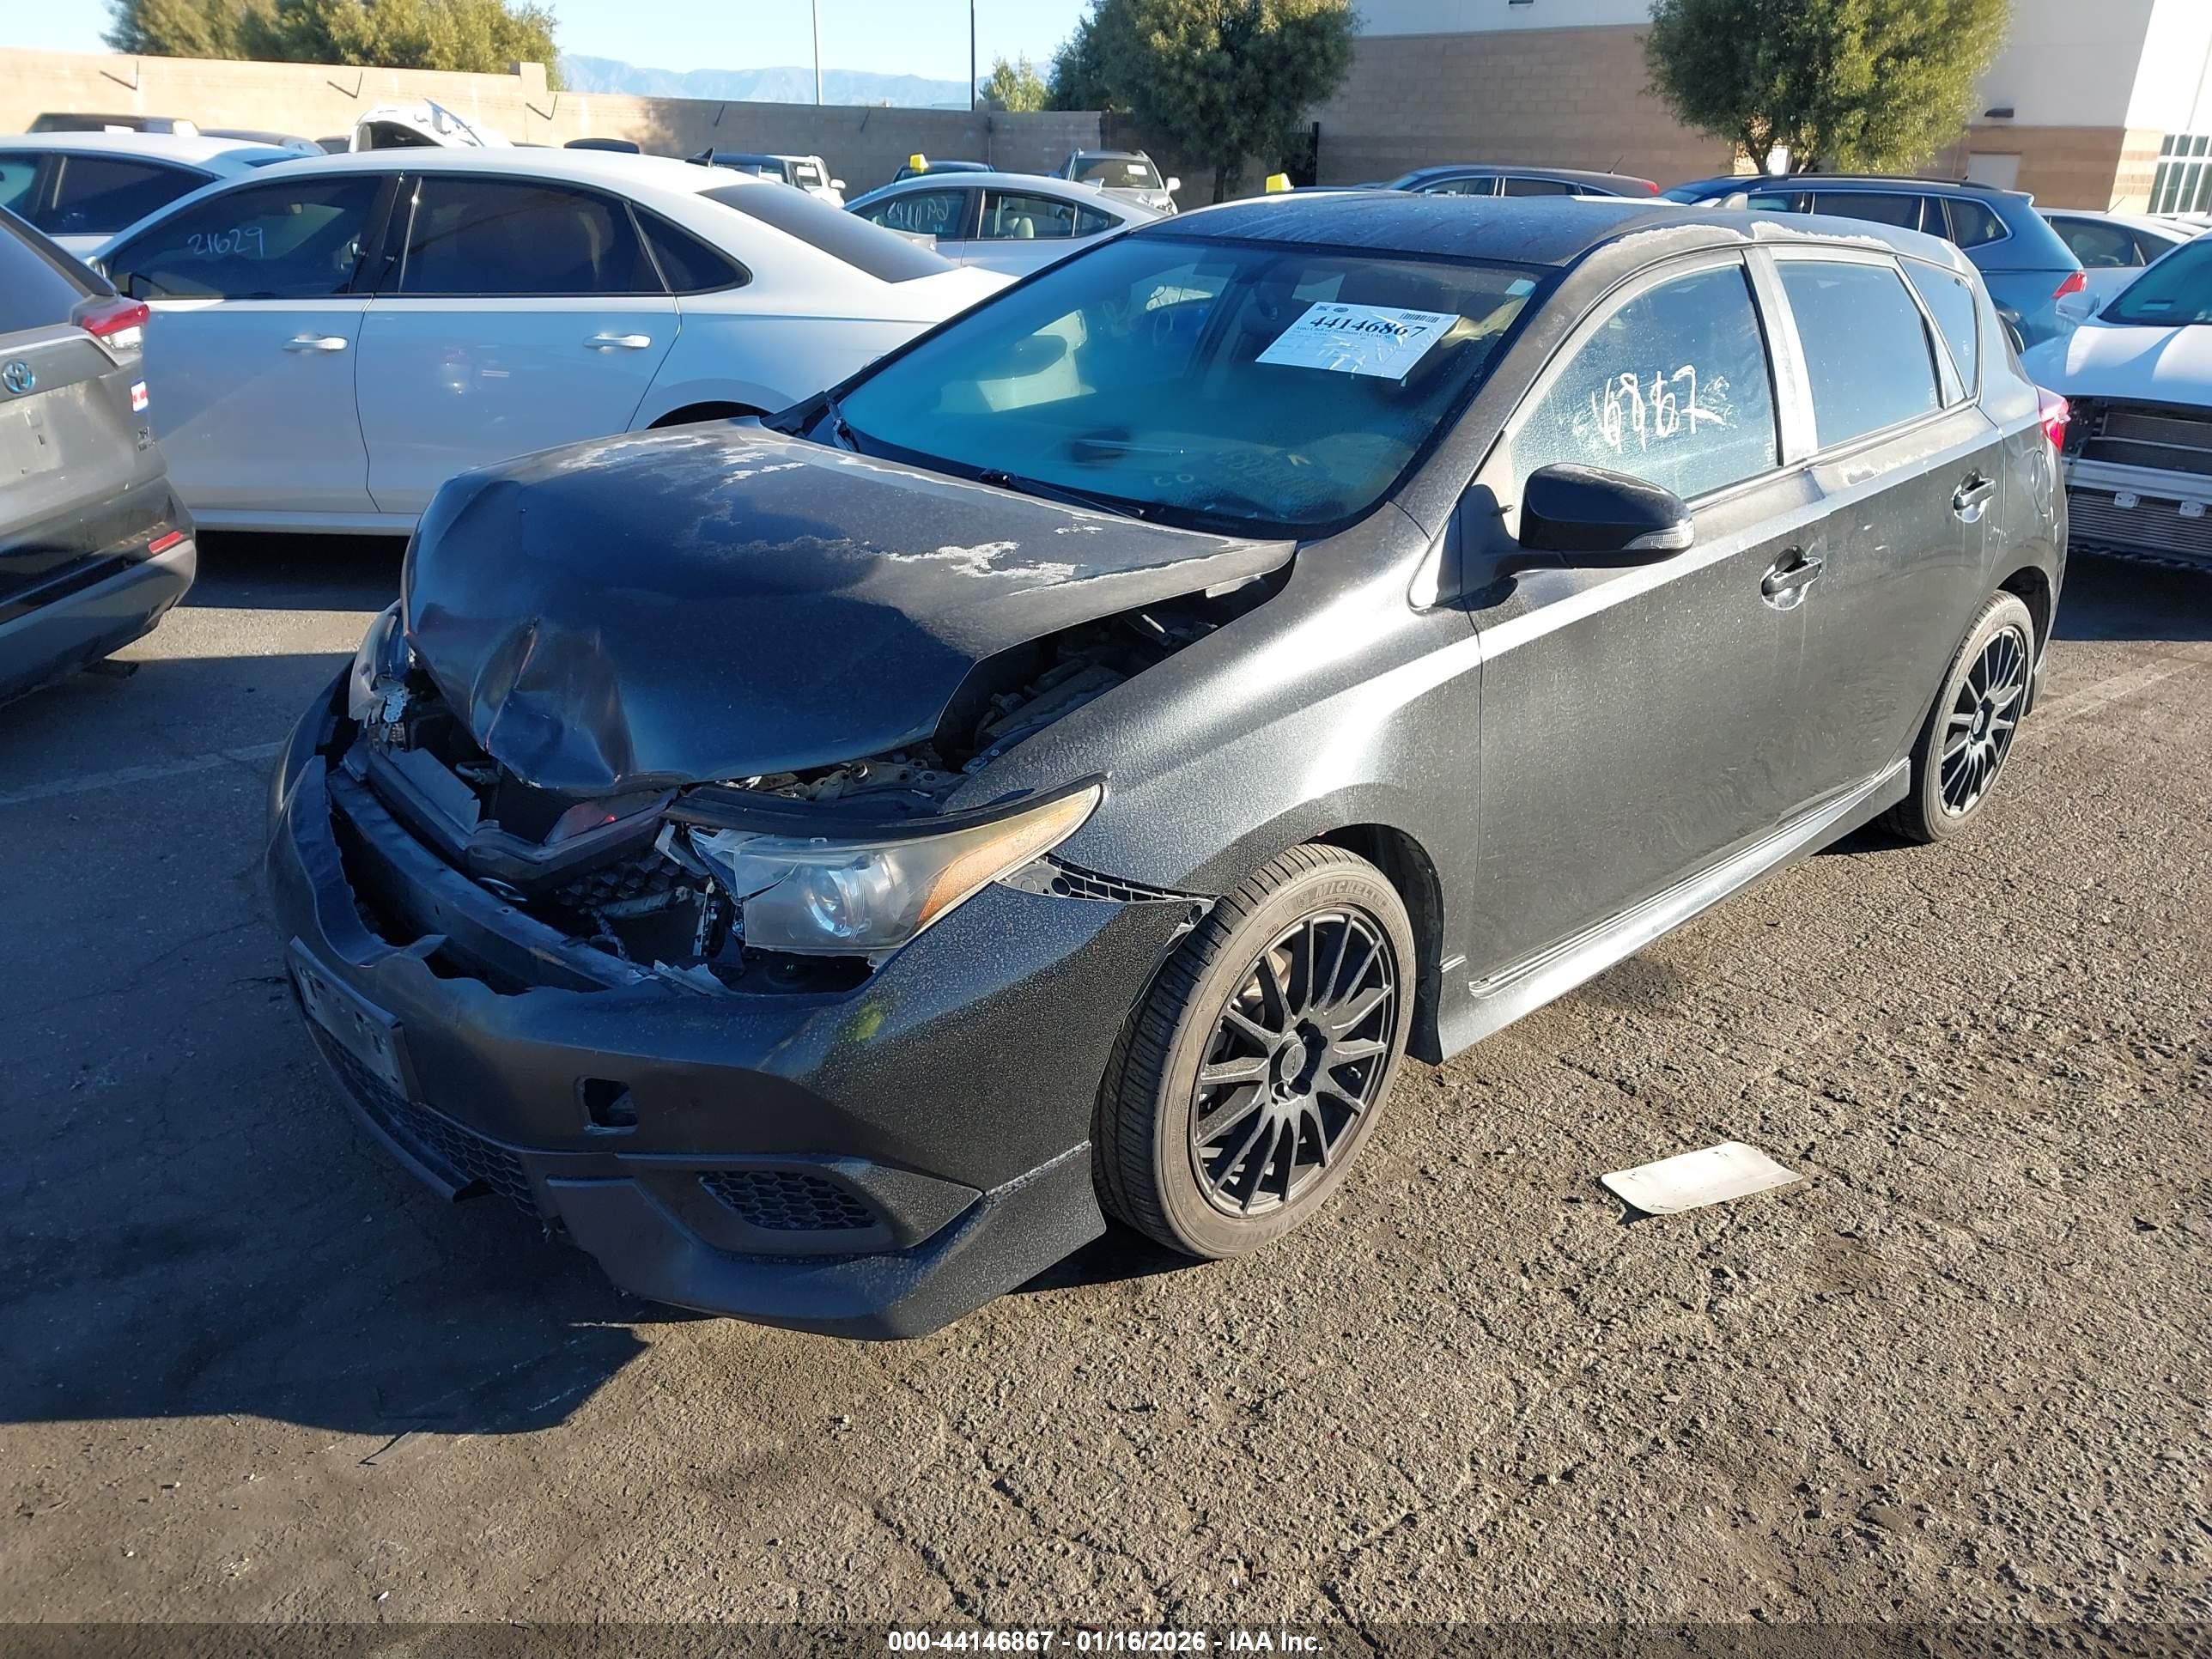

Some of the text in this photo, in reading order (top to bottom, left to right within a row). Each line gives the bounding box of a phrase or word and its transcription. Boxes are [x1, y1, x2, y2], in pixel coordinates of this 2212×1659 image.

[187, 226, 264, 257] 21629
[1310, 315, 1428, 337] 44146867
[1316, 879, 1389, 907] MICHELIN
